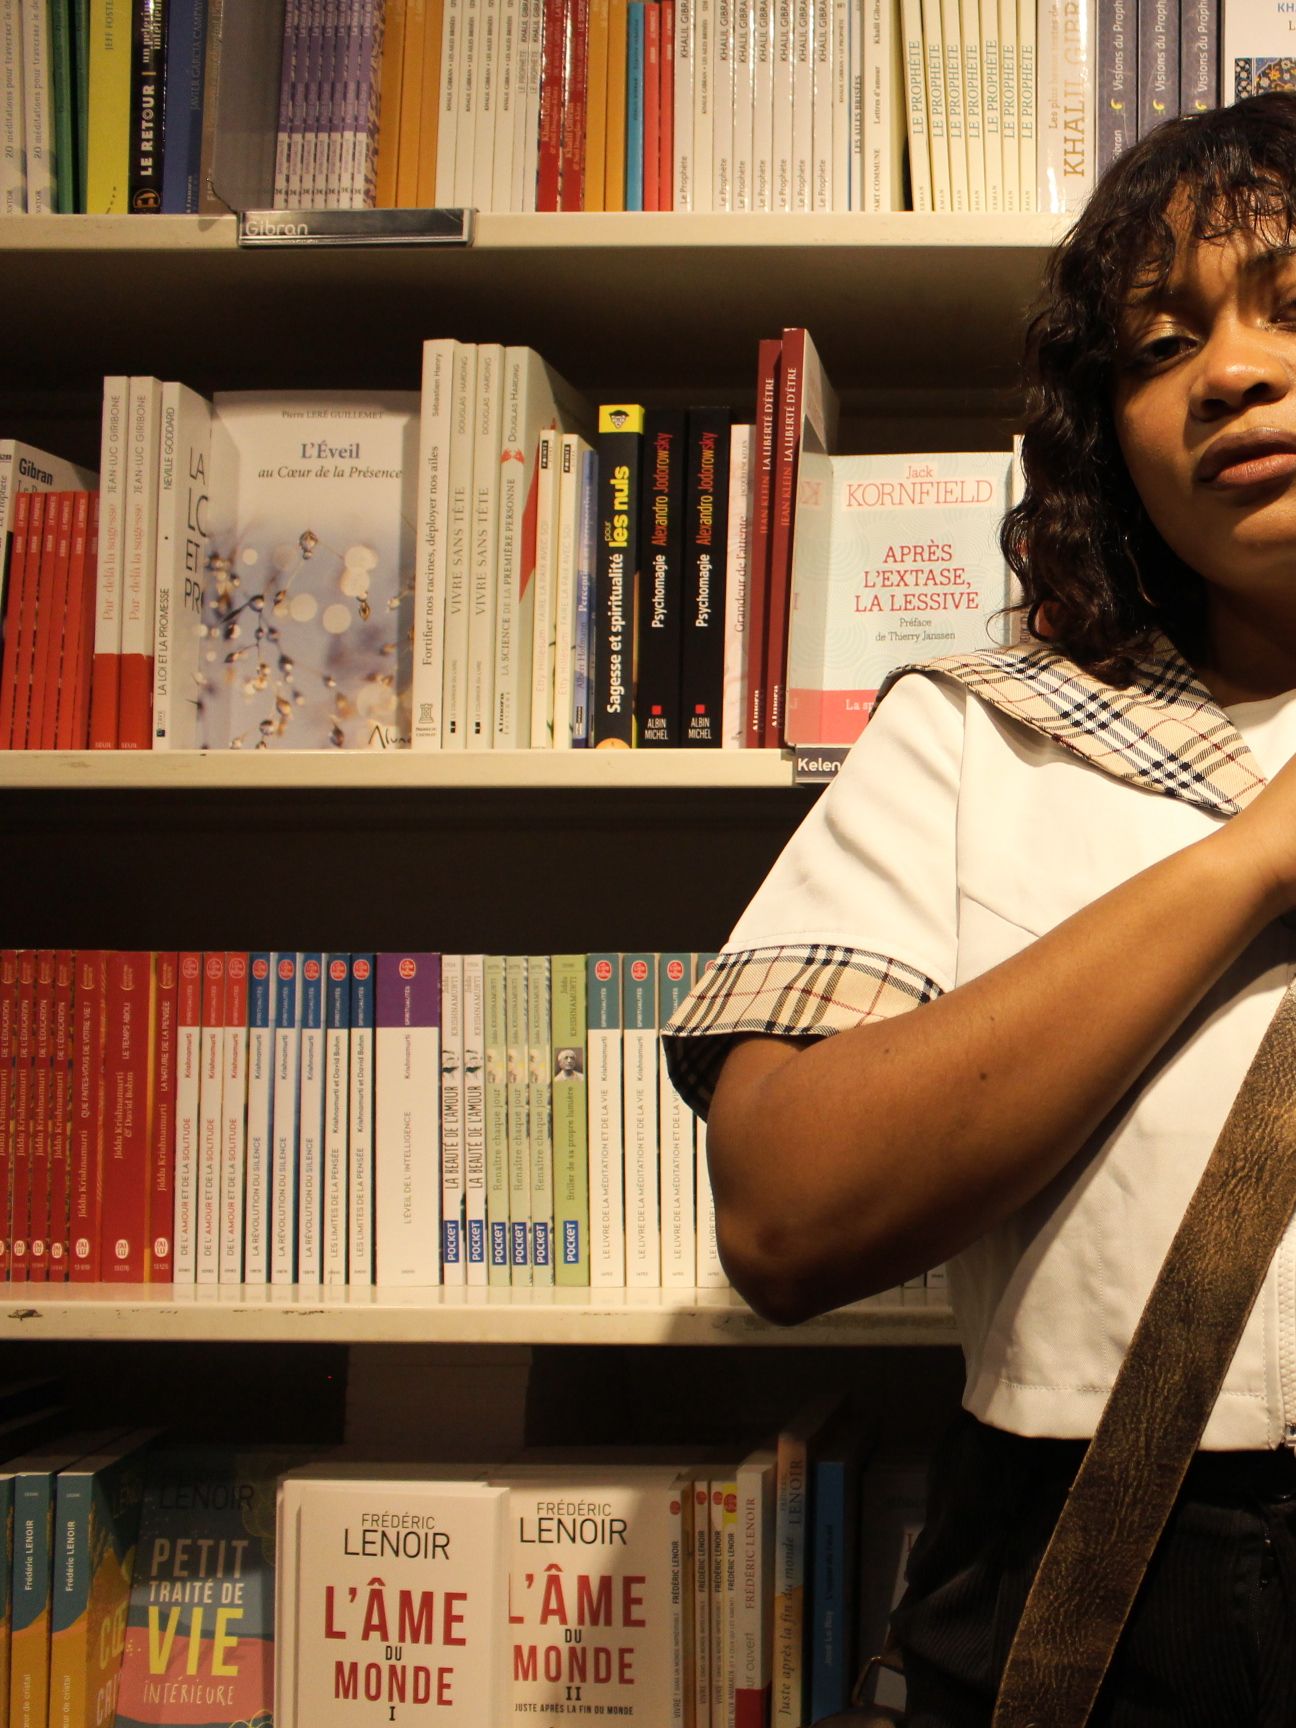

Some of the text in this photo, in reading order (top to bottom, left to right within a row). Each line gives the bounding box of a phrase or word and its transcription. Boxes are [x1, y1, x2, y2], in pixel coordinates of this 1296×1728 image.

[908, 41, 924, 134] LE PROPHÈTE
[141, 85, 154, 175] LE RETOUR
[245, 220, 309, 236] Gibran
[783, 367, 798, 461] LA LIBERTÉ D'ÊTRE
[301, 440, 360, 459] L'Éveil
[18, 458, 54, 486] Gibran
[258, 466, 402, 478] au Cœur de la Présence
[906, 466, 934, 479] Jack
[846, 480, 992, 507] KORNFIELD
[609, 466, 629, 548] les nuls
[651, 433, 672, 627] Psychomagie Alexandro Jodorowsky
[422, 446, 440, 666] Fortifier nos racines, déployer nos ailes
[883, 540, 952, 563] APRÈS
[864, 568, 971, 589] L'EXTASE,
[854, 592, 979, 613] LA LESSIVE
[607, 554, 624, 713] Sagesse et spiritualité
[900, 617, 932, 627] Préface
[875, 630, 955, 644] de Thierry Janssen
[644, 730, 668, 740] MICHEL
[647, 718, 667, 729] ALBIN
[798, 758, 841, 772] Kelen
[466, 1085, 483, 1189] LA BEAUTÉ DE L'AMOUR
[537, 1499, 612, 1516] FRÉDÉRIC
[361, 1511, 436, 1529] FRÉDÉRIC
[520, 1517, 627, 1545] LENOIR
[344, 1528, 450, 1560] LENOIR
[150, 1538, 249, 1578] PETIT
[149, 1580, 244, 1604] TRAITÉ DE
[509, 1564, 646, 1627] L'ÂME
[325, 1577, 468, 1646] L'ÂME
[147, 1606, 244, 1676] VIE
[565, 1628, 582, 1643] DU
[385, 1645, 402, 1661] DU
[513, 1645, 634, 1685] MONDE
[334, 1661, 454, 1706] MONDE
[566, 1687, 581, 1700] II
[389, 1706, 395, 1721] I
[515, 1703, 634, 1715] JUSTE APRÈS LA FIN DU MONDE
